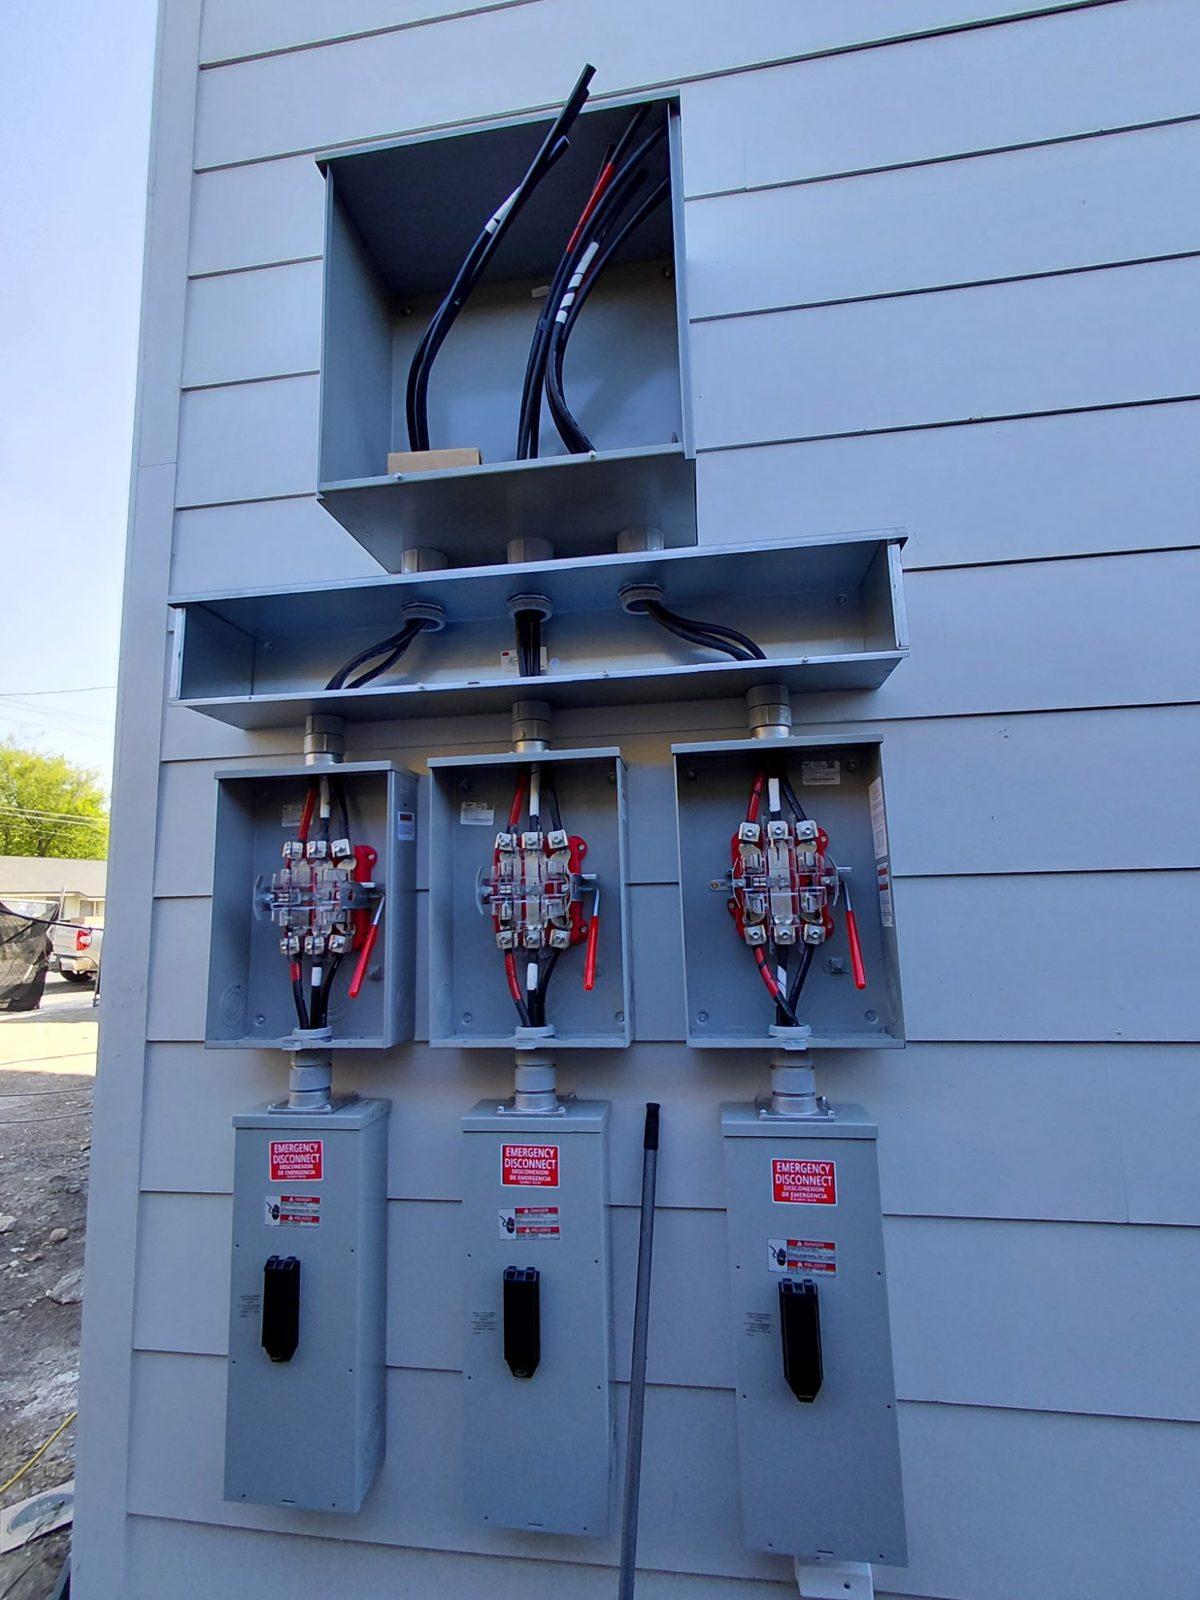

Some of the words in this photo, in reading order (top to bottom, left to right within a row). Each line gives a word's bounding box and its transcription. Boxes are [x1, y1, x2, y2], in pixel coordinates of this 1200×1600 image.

[274, 1143, 318, 1154] EMERGENCY
[506, 1146, 555, 1158] EMERGENCY
[273, 1154, 320, 1164] DISCONNECT
[504, 1158, 556, 1169] DISCONNECT
[776, 1162, 830, 1174] EMERGENCY
[775, 1174, 832, 1186] DISCONNECT
